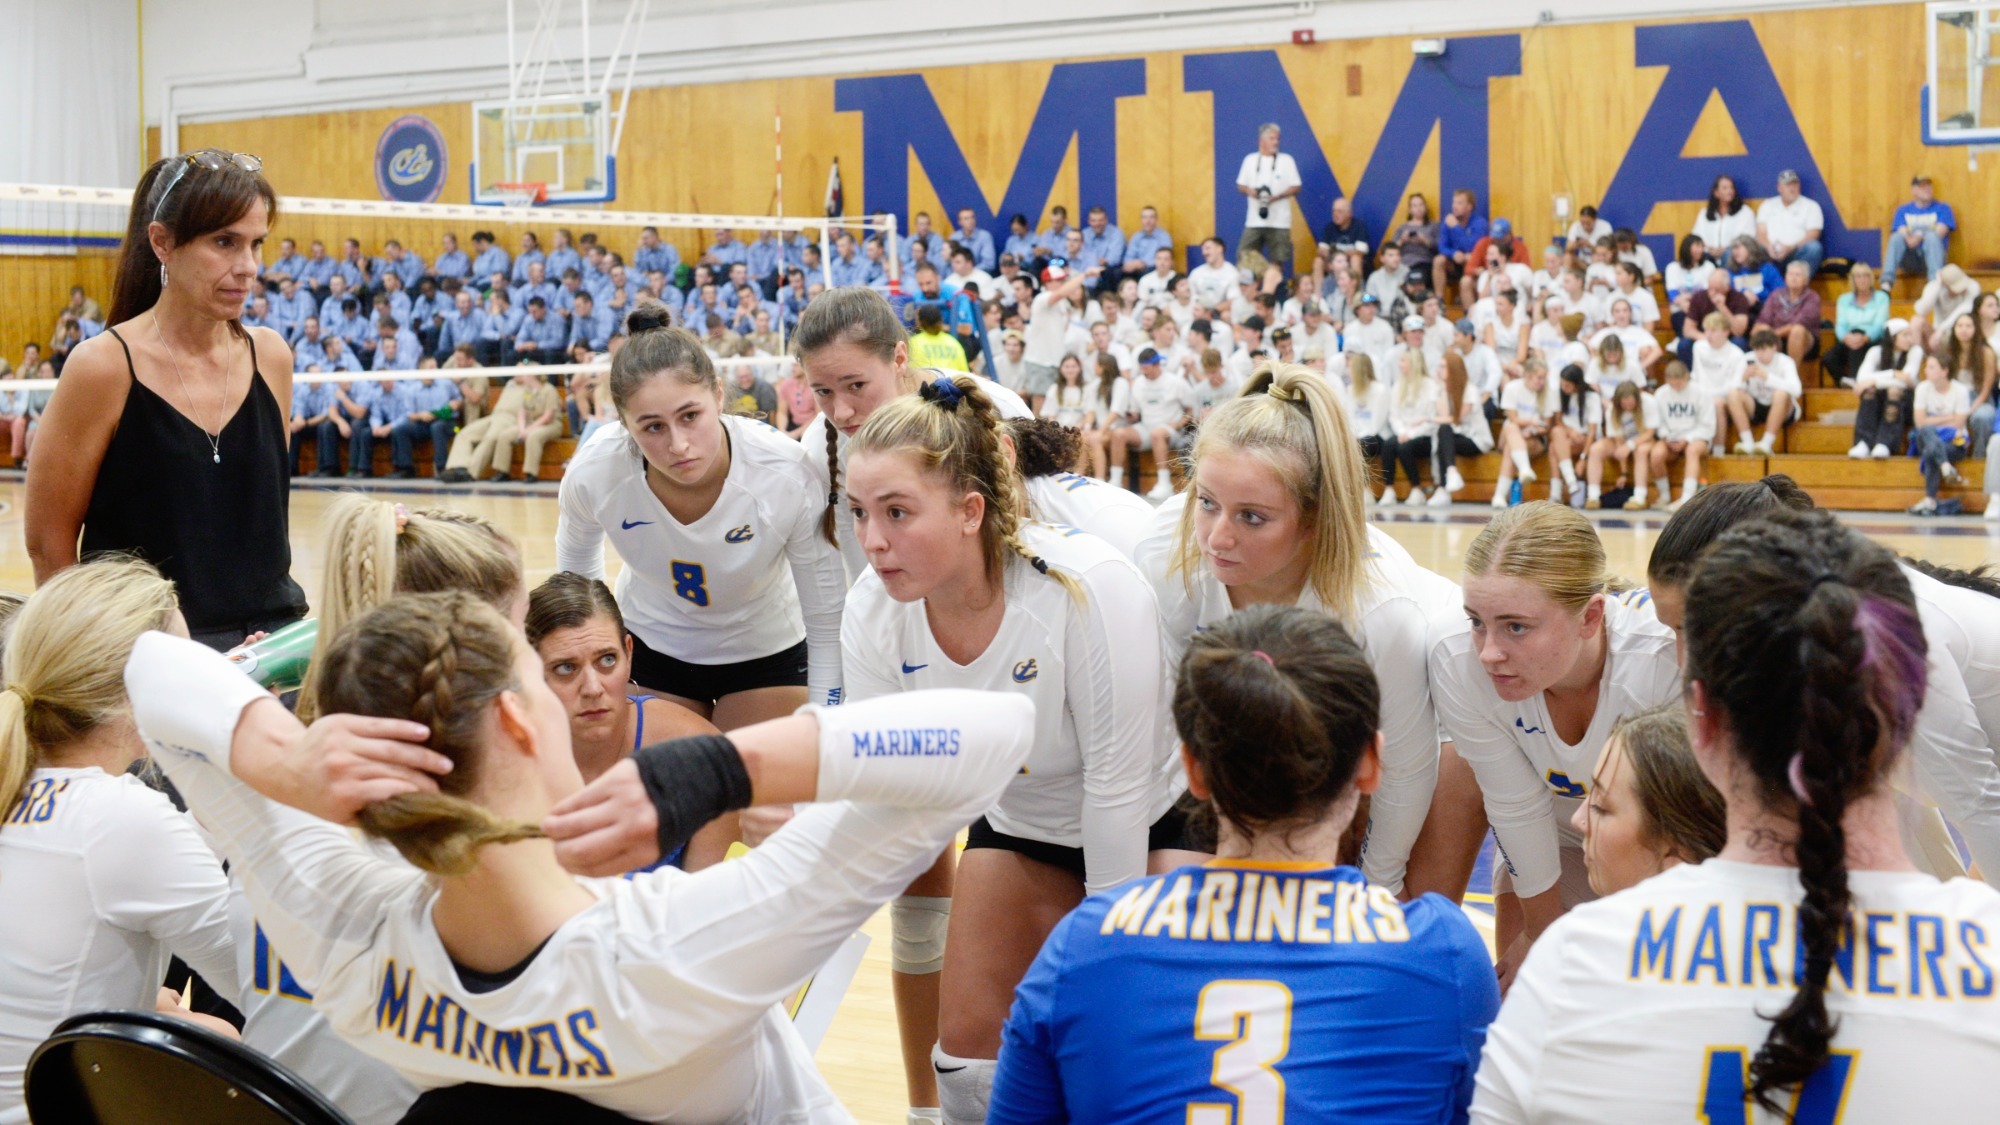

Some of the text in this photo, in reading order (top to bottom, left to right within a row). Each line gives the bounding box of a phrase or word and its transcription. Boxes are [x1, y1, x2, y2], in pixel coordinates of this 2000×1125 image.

[834, 20, 1881, 283] MMA
[1667, 402, 1696, 418] MMA
[670, 558, 711, 607] 8
[852, 728, 961, 758] MARINERS
[1100, 871, 1411, 944] MARINERS
[1186, 979, 1294, 1125] 3
